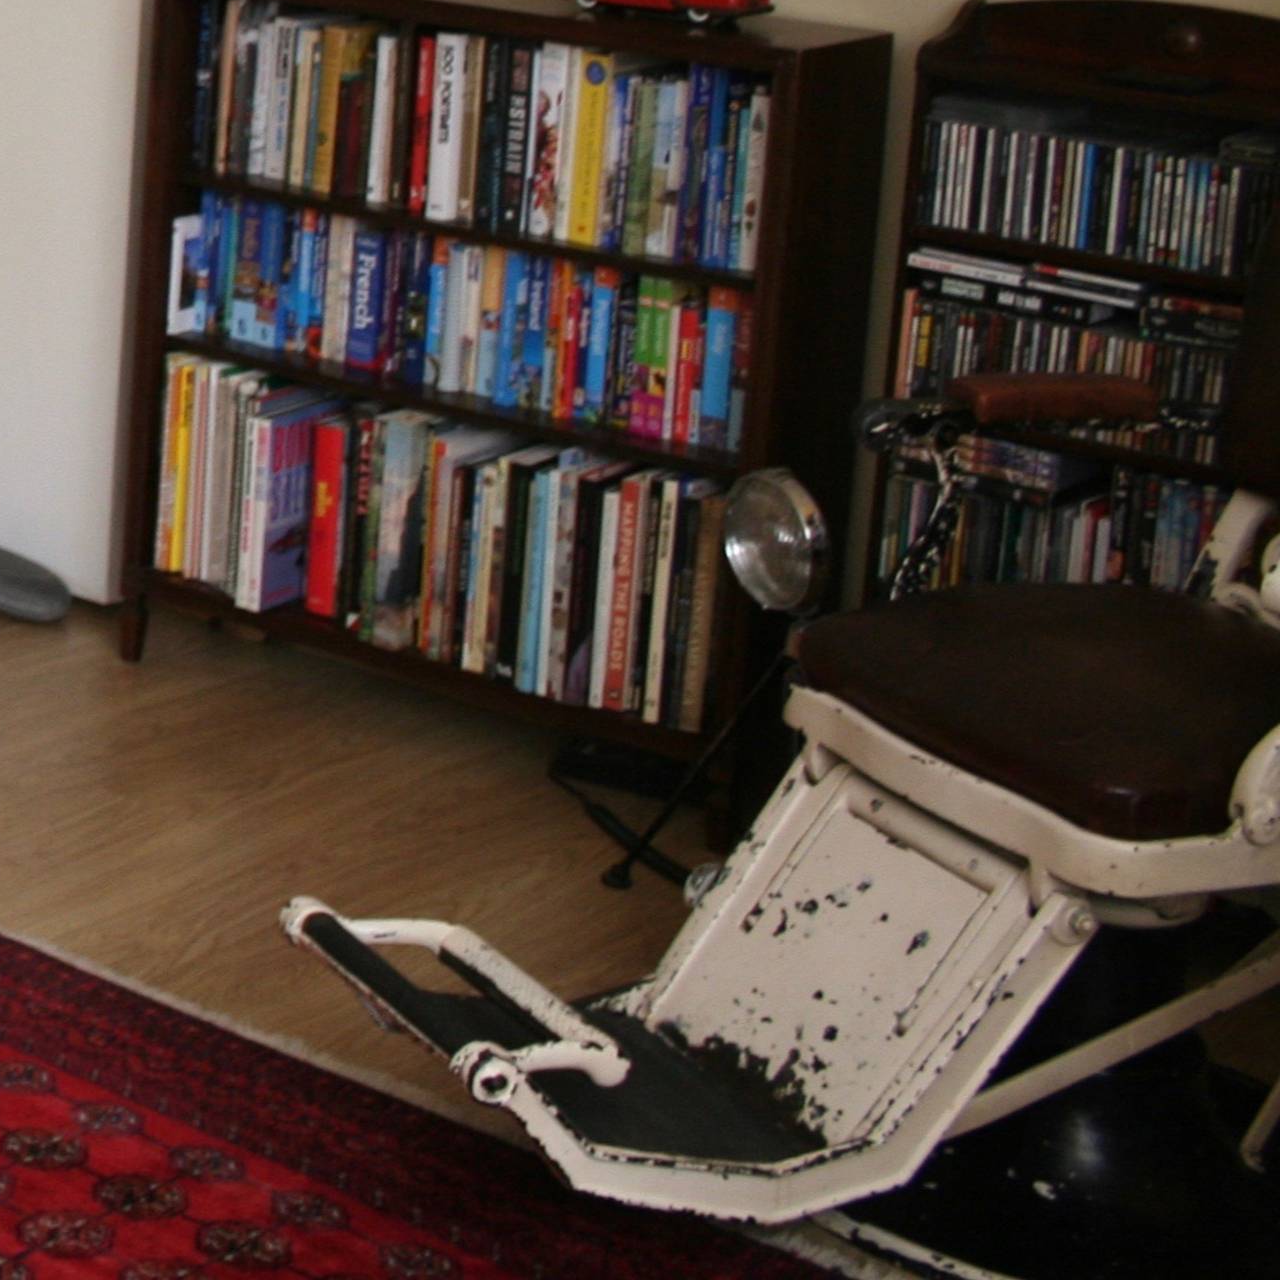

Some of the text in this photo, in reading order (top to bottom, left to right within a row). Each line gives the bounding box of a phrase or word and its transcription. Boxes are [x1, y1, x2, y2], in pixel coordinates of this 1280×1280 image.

[353, 252, 377, 331] French
[618, 501, 634, 576] MAPPING
[609, 616, 625, 673] ROADS
